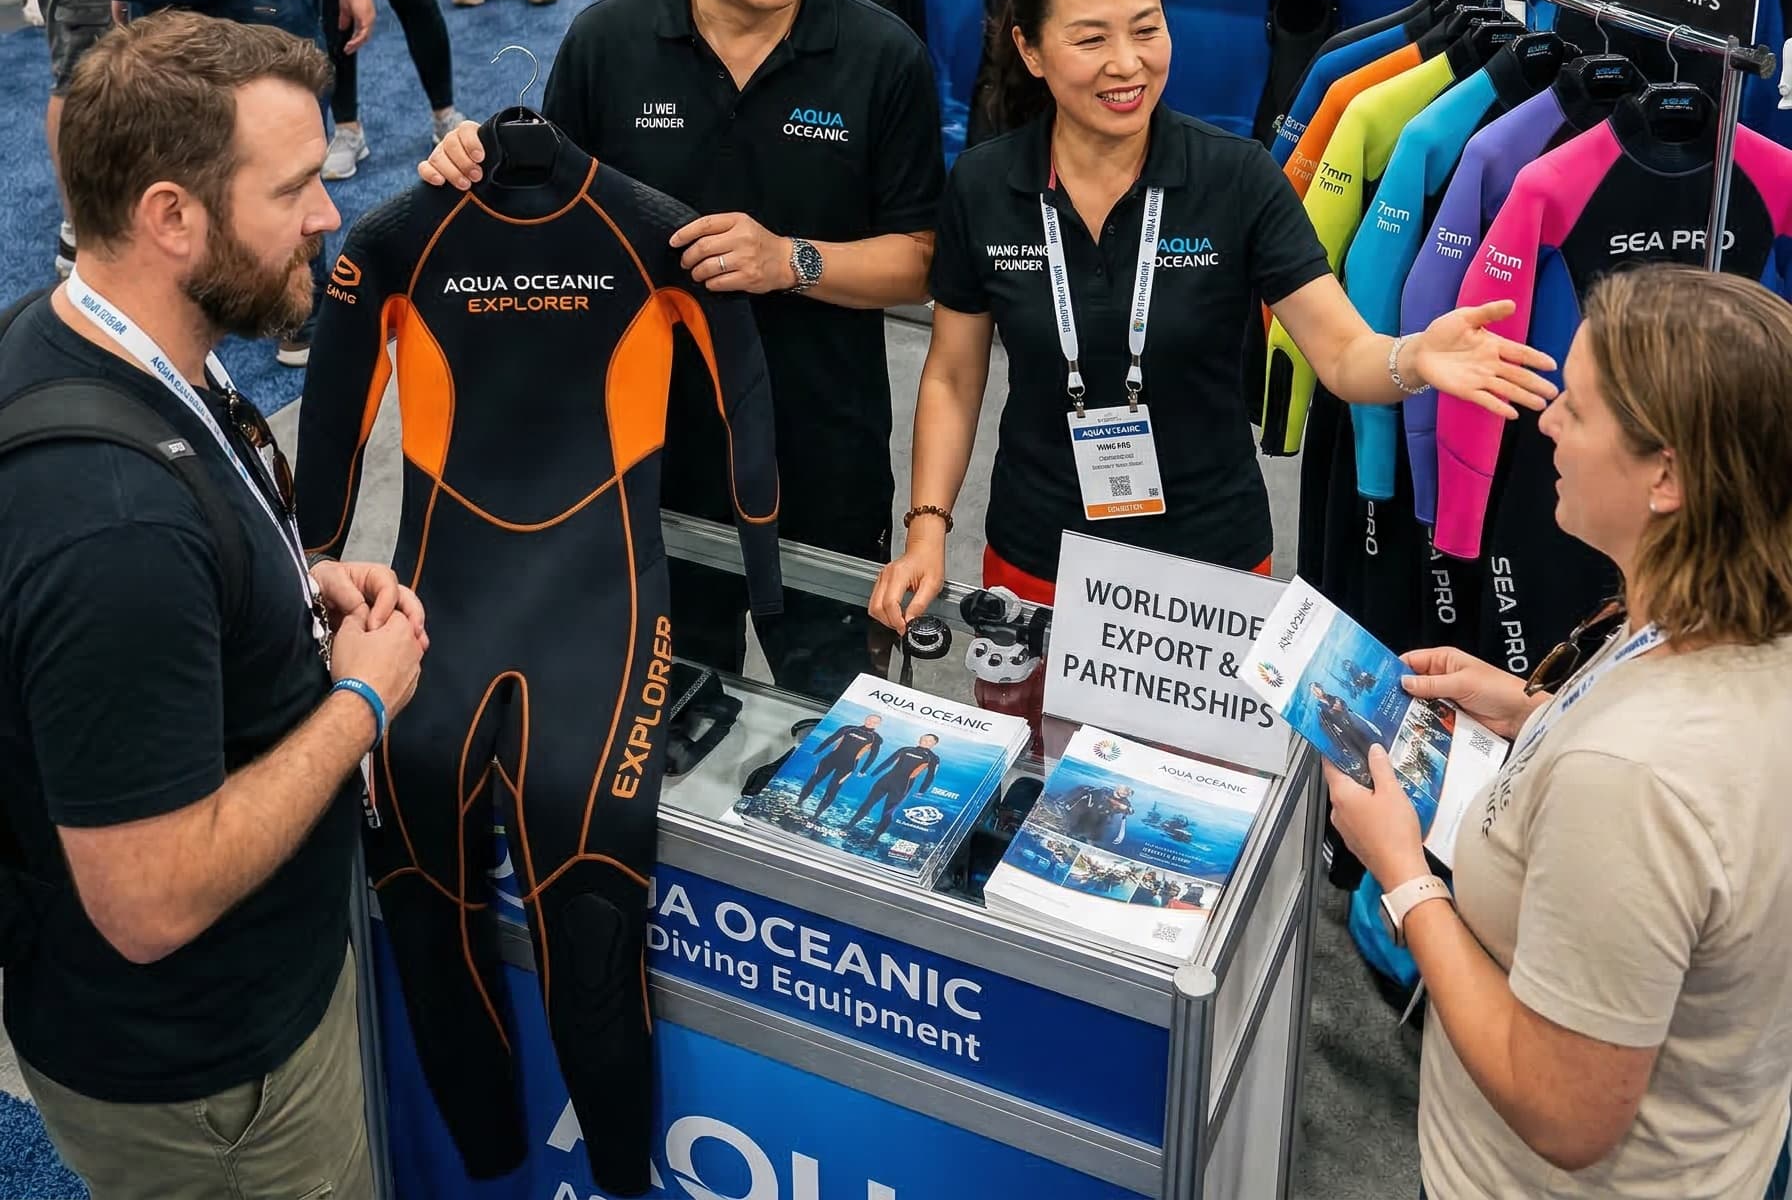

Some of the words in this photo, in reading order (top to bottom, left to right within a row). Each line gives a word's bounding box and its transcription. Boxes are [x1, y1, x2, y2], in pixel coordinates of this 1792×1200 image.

[655, 103, 676, 115] WEI
[789, 107, 844, 128] AQUA
[635, 117, 684, 129] FOUNDER
[783, 122, 849, 142] OCEANIC
[1320, 161, 1353, 185] 7mm
[1319, 176, 1345, 196] 7mm
[1378, 200, 1410, 222] 7mm
[986, 244, 1019, 258] WANG
[1021, 244, 1049, 257] FANG
[1156, 237, 1213, 254] AQUA
[1436, 242, 1463, 260] 7mm
[1609, 231, 1665, 255] SEA
[1672, 230, 1736, 251] PRO
[994, 259, 1043, 272] FOUNDER
[1153, 252, 1219, 269] OCEANIC
[1486, 245, 1523, 269] 7mm
[1484, 262, 1513, 283] 7mm
[443, 275, 508, 294] AQUA
[514, 274, 615, 292] OCEANIC
[468, 296, 590, 313] EXPLORER
[1082, 428, 1105, 439] AQUA
[1491, 556, 1517, 613] SEA
[1431, 569, 1457, 624] PRO
[1085, 577, 1265, 641] WORLDWIDE
[1101, 622, 1213, 671] EXPORT
[1218, 651, 1239, 679] &
[1501, 620, 1529, 673] PRO
[1063, 653, 1274, 728] PARTNERSHIPS
[868, 689, 915, 714] AQUA
[920, 705, 993, 732] OCEANIC
[1196, 775, 1248, 794] OCEANIC
[714, 901, 983, 1021] OCEANIC
[647, 923, 758, 990] Diving
[772, 965, 981, 1062] Equipment
